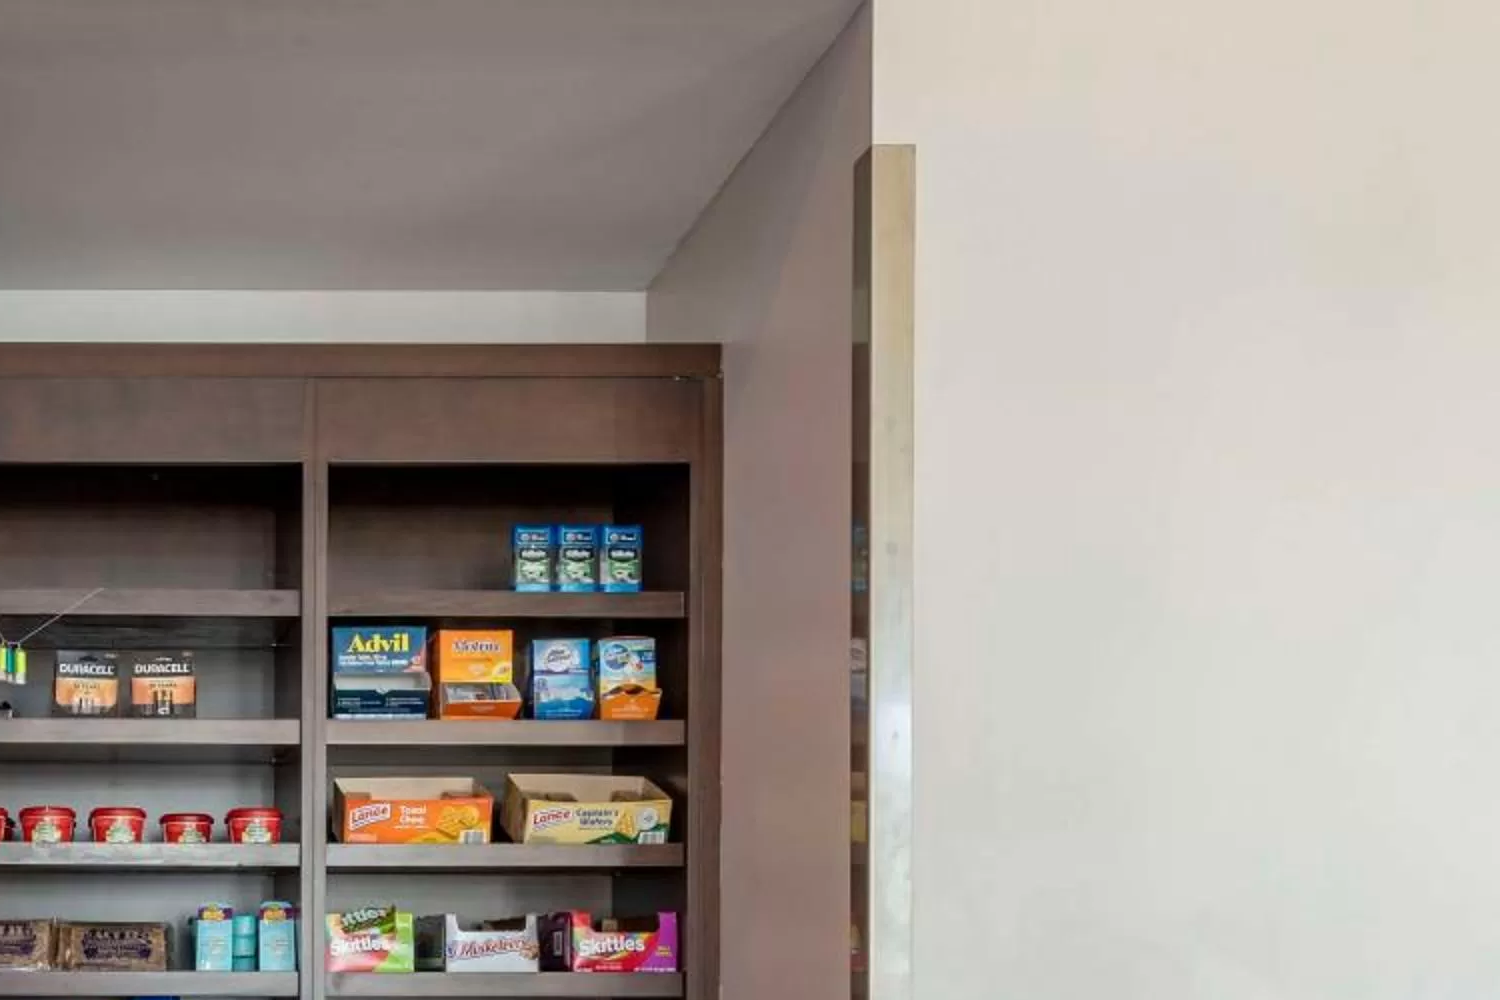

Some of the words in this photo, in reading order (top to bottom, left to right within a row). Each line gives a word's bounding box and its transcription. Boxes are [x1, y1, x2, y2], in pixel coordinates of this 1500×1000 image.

[347, 632, 410, 654] Advil
[60, 663, 114, 675] DURACELL
[135, 663, 190, 673] DURACELL
[351, 804, 388, 825] Lance
[533, 809, 572, 826] Lance
[342, 909, 386, 927] ittles
